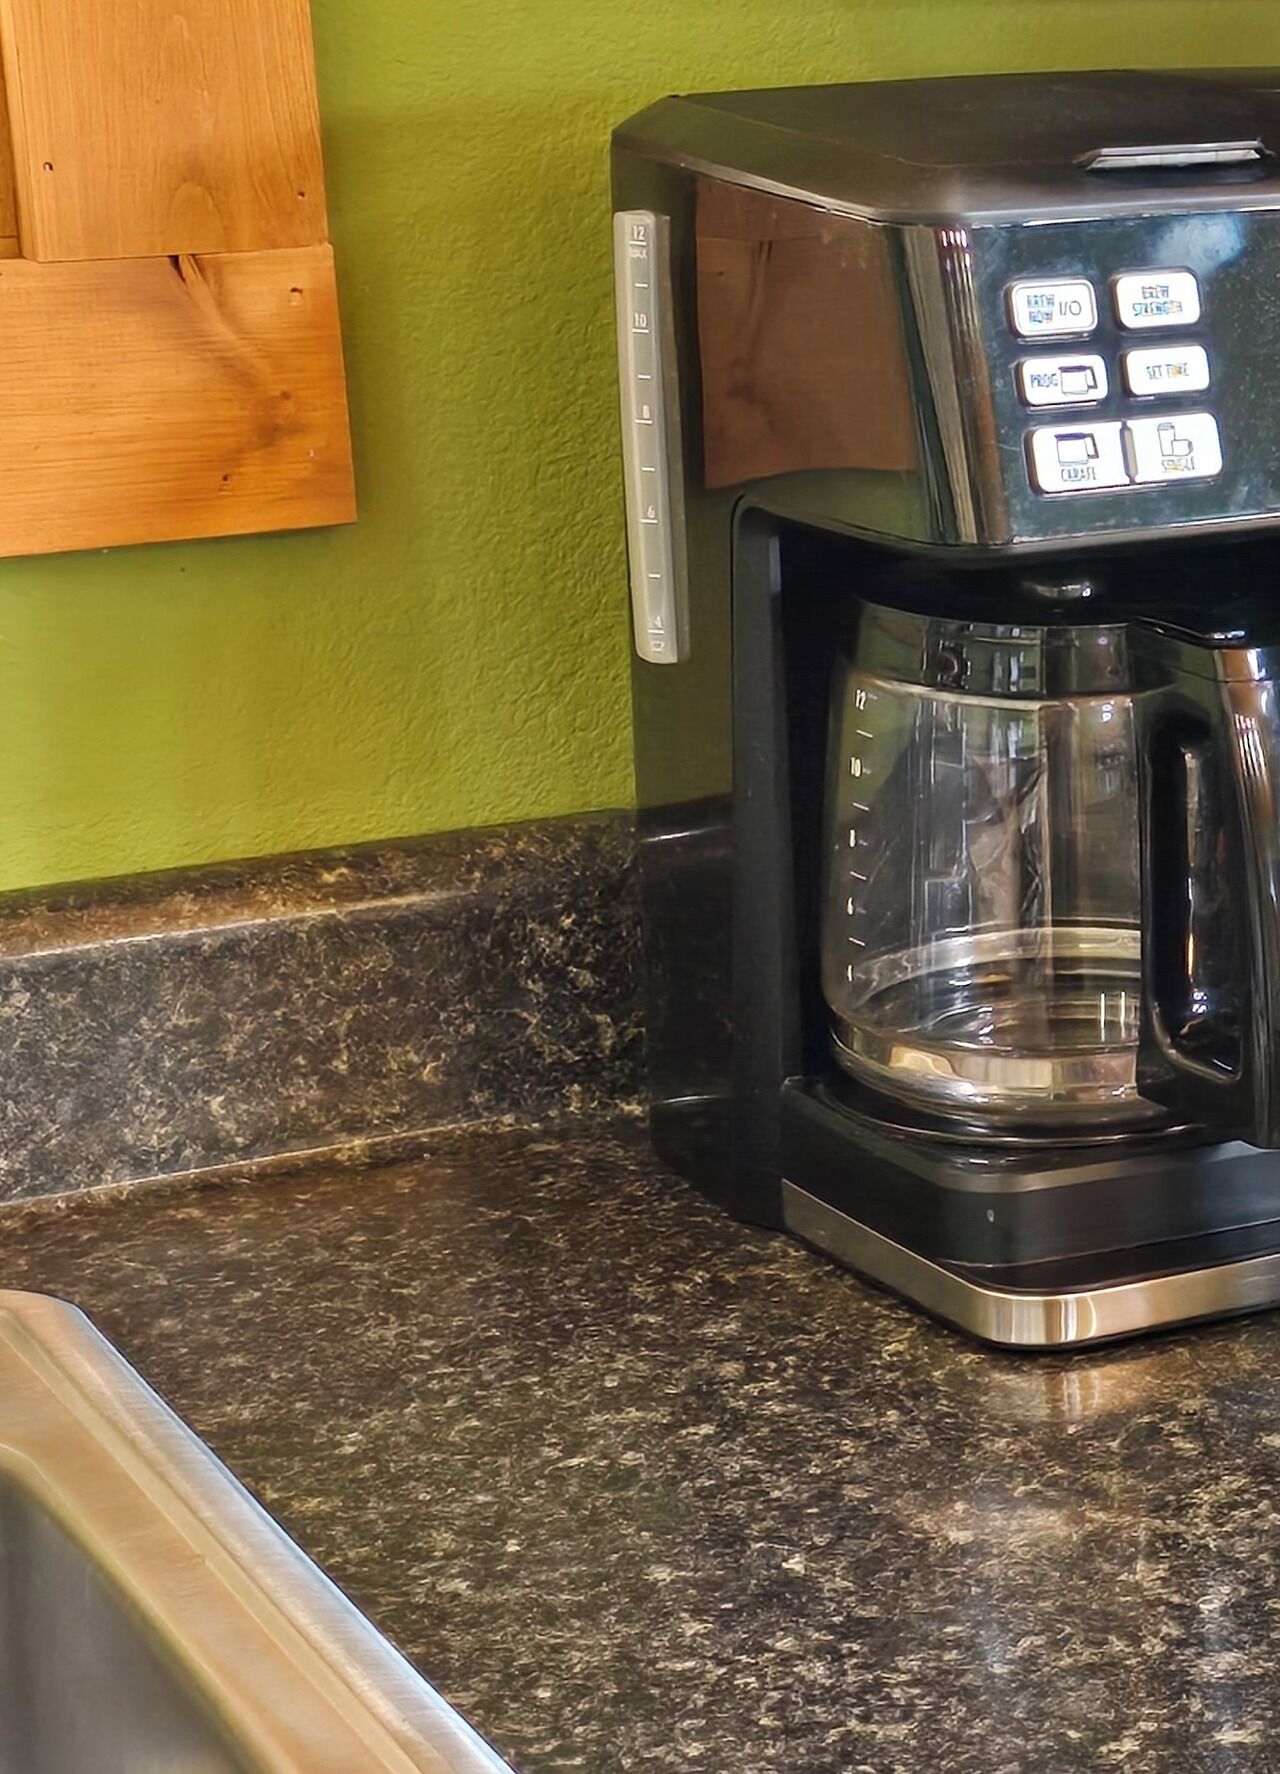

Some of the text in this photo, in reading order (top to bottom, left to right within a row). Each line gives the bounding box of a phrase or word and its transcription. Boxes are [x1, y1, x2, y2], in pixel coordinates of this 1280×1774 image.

[633, 225, 645, 240] 12
[634, 313, 647, 328] 10
[647, 505, 656, 519] 6
[855, 689, 867, 711] 12
[850, 756, 862, 778] 10
